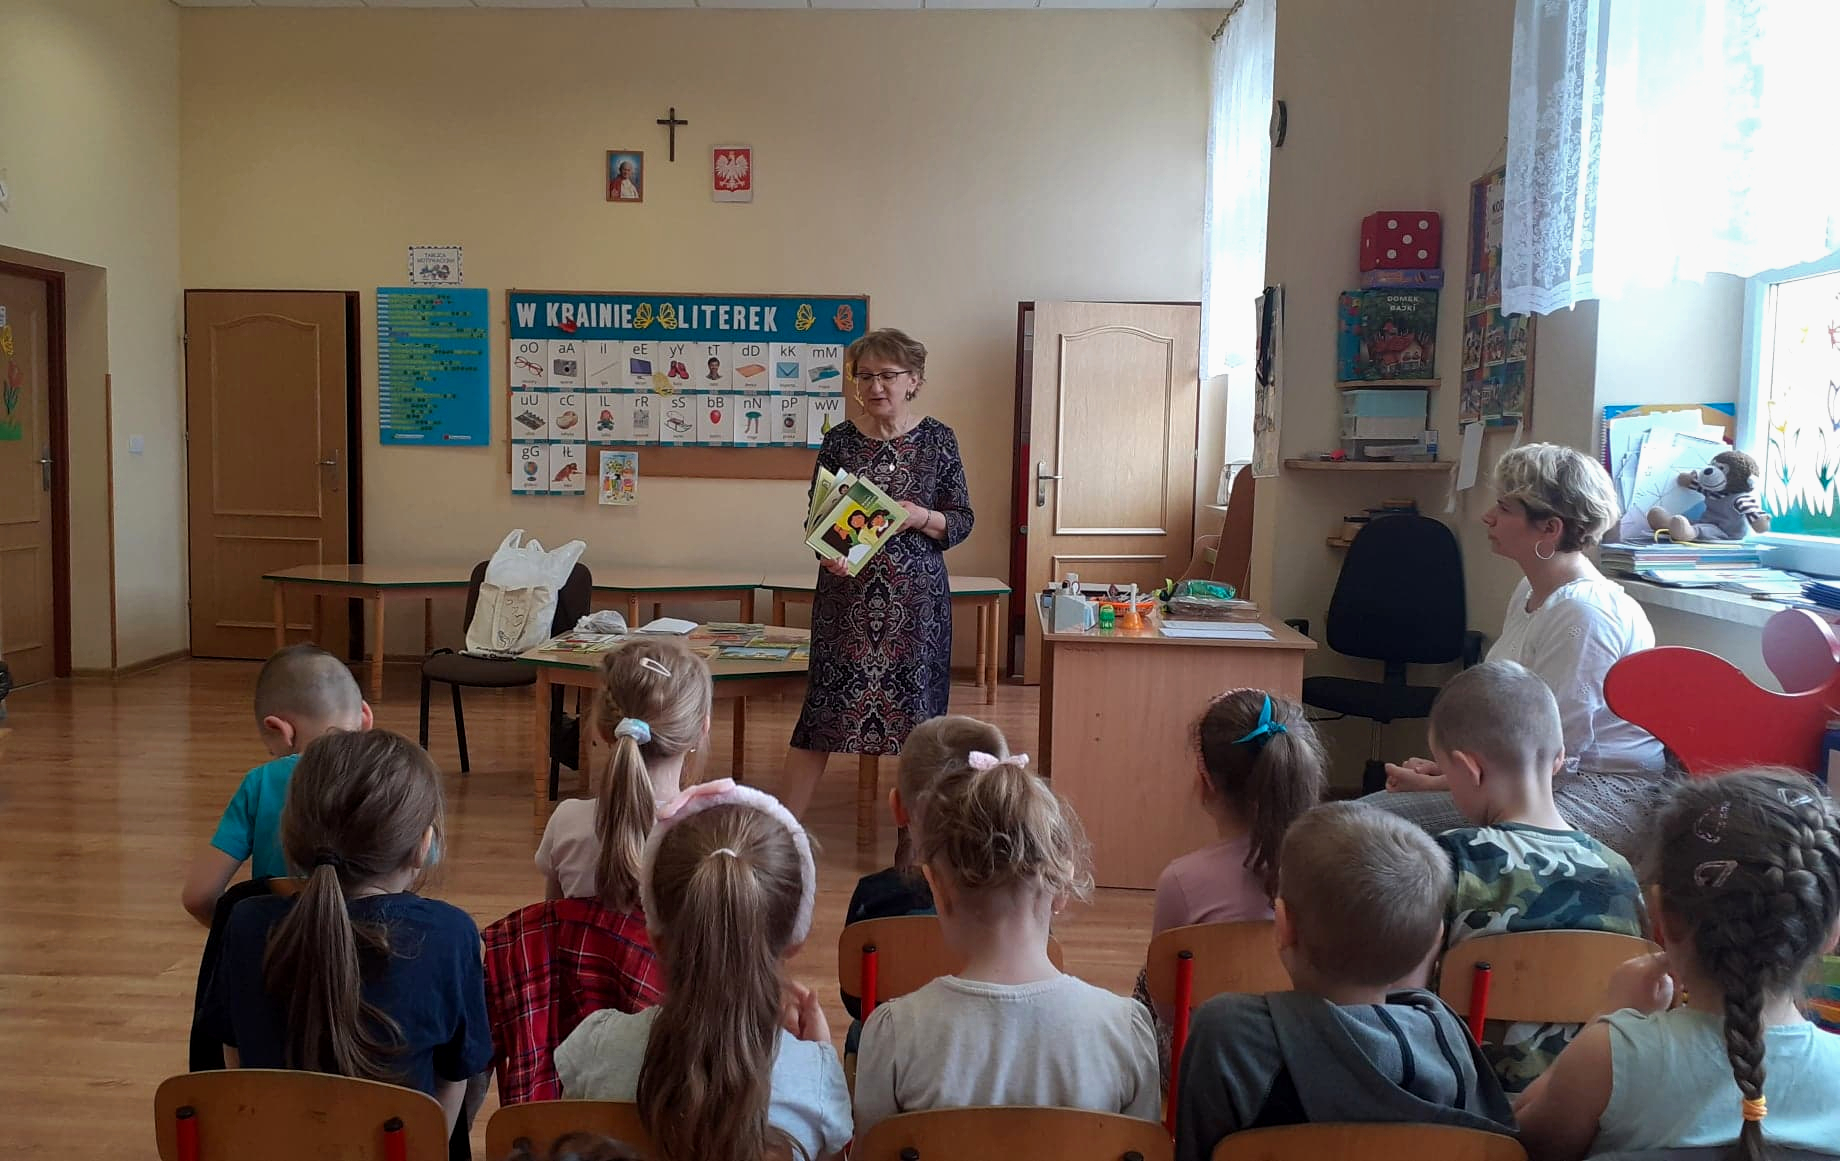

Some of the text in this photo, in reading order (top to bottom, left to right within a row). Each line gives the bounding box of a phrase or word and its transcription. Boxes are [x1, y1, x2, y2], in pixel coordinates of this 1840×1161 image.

[516, 302, 777, 332] W KRAINIE LITEREK
[520, 342, 538, 353] oO
[559, 343, 575, 353] aA
[633, 344, 648, 354] eE
[670, 344, 684, 358] yY
[708, 345, 720, 355] tT
[742, 345, 760, 356] dD
[781, 346, 795, 356] kK
[813, 347, 837, 358] mM
[521, 395, 538, 405] uU
[560, 395, 574, 406] cC
[636, 396, 648, 407] rR
[672, 397, 685, 408] sS
[708, 397, 723, 408] bB
[744, 398, 761, 408] nN
[782, 397, 797, 411] pP
[815, 400, 838, 410] wW
[522, 445, 540, 459] gG
